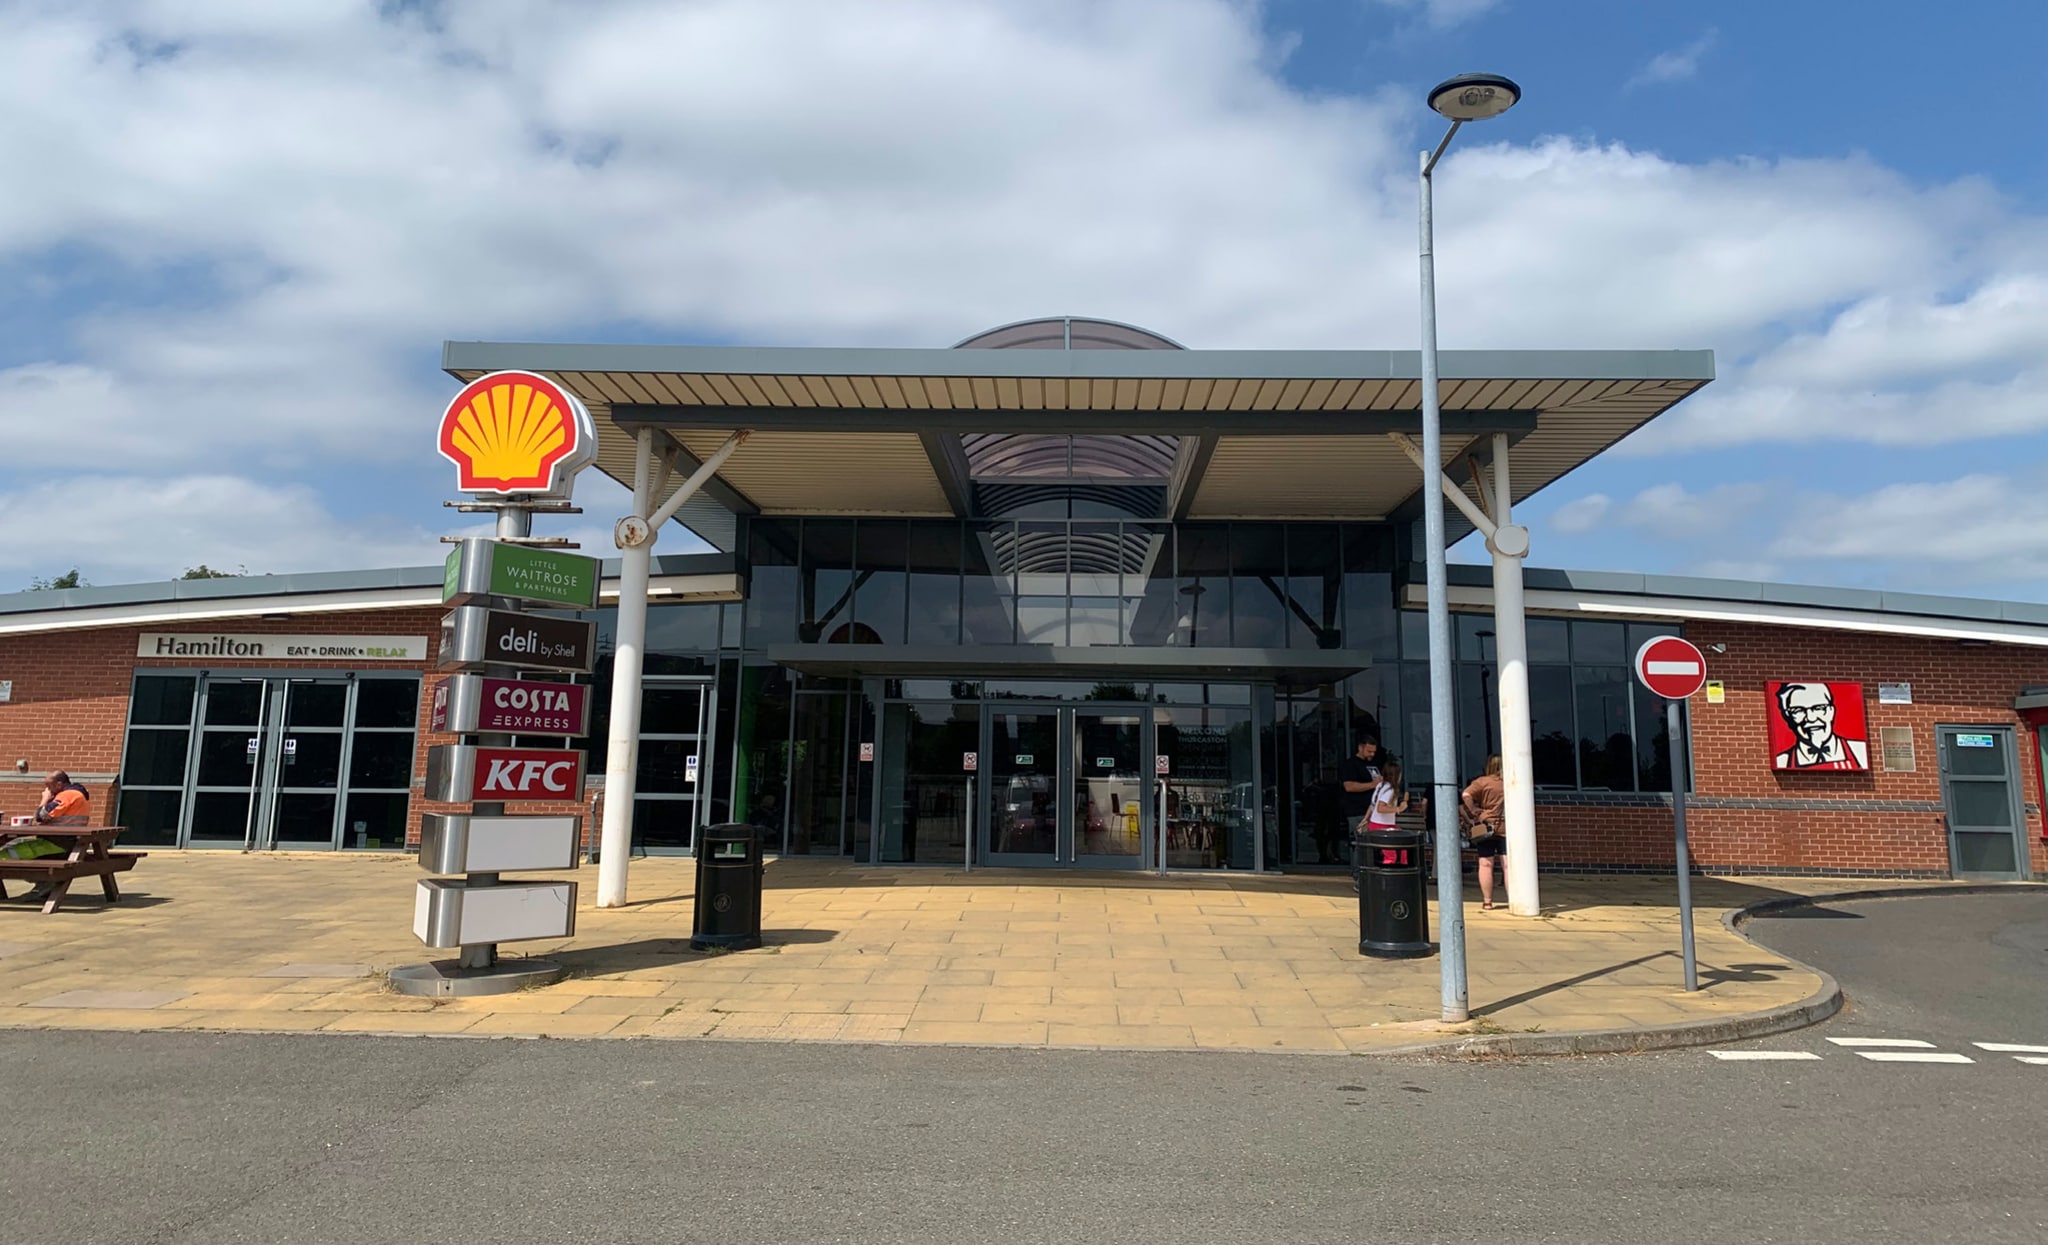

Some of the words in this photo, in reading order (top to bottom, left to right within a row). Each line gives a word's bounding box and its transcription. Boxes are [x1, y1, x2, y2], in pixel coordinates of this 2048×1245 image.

[529, 559, 557, 570] LITTLE
[506, 565, 578, 587] WAITROSE
[515, 581, 520, 589] &
[523, 582, 568, 596] PARTNERS
[156, 636, 263, 656] Hamilton
[287, 646, 310, 656] EAT
[319, 646, 357, 657] DRINK
[366, 647, 407, 658] RELAX
[499, 627, 538, 654] deli
[540, 642, 553, 658] by
[554, 643, 576, 658] Shell
[494, 686, 570, 713] COSTA
[504, 715, 569, 729] EXPRESS
[481, 759, 571, 792] KFC
